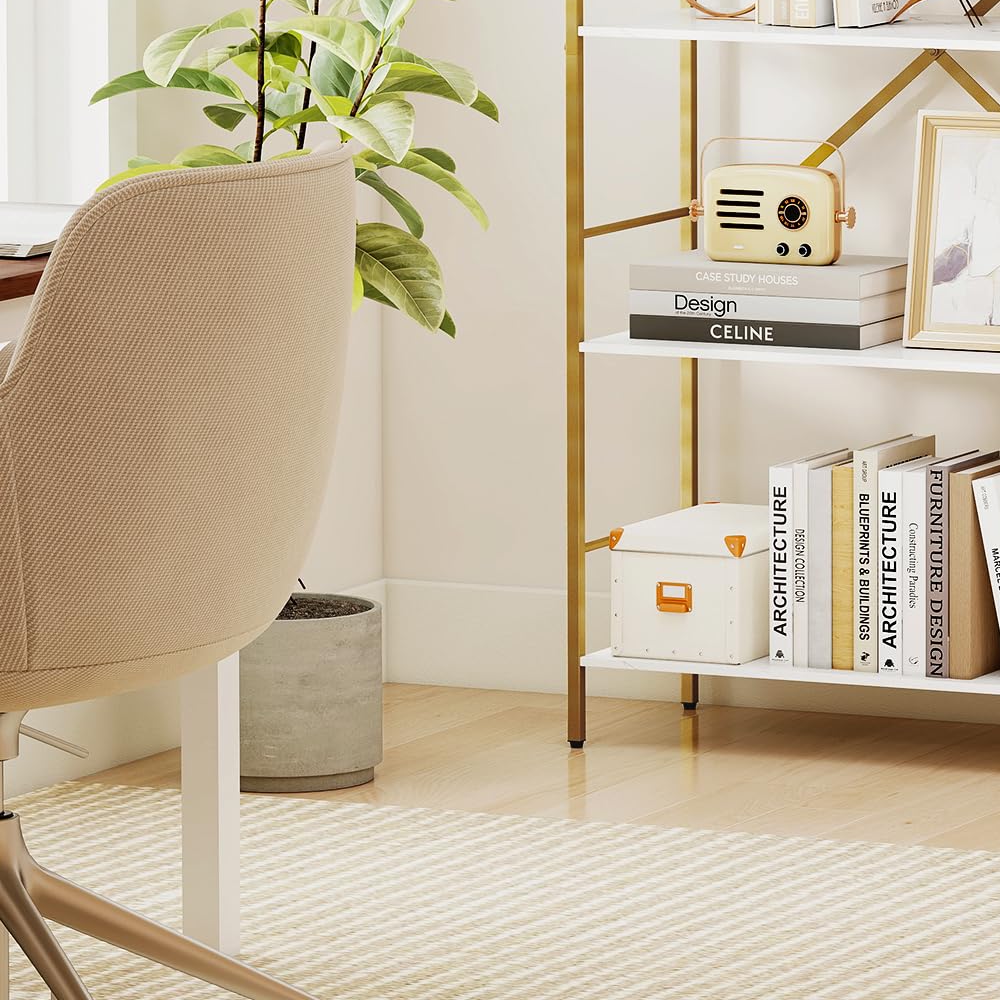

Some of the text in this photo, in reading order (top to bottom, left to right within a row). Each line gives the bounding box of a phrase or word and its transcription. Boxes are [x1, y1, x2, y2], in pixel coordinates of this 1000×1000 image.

[675, 294, 737, 317] Design
[695, 271, 799, 286] CASE STUDY HOUSES
[710, 323, 774, 341] CELINE
[773, 486, 788, 637] ARCHITECTURE
[794, 528, 806, 603] DESIGN COLLECTION
[858, 493, 870, 641] BLUEPRINTS & BUILDINGS
[881, 491, 897, 649] ARCHITECTURE
[907, 521, 919, 574] Constructing
[929, 469, 944, 677] FURNITURE DESIGN
